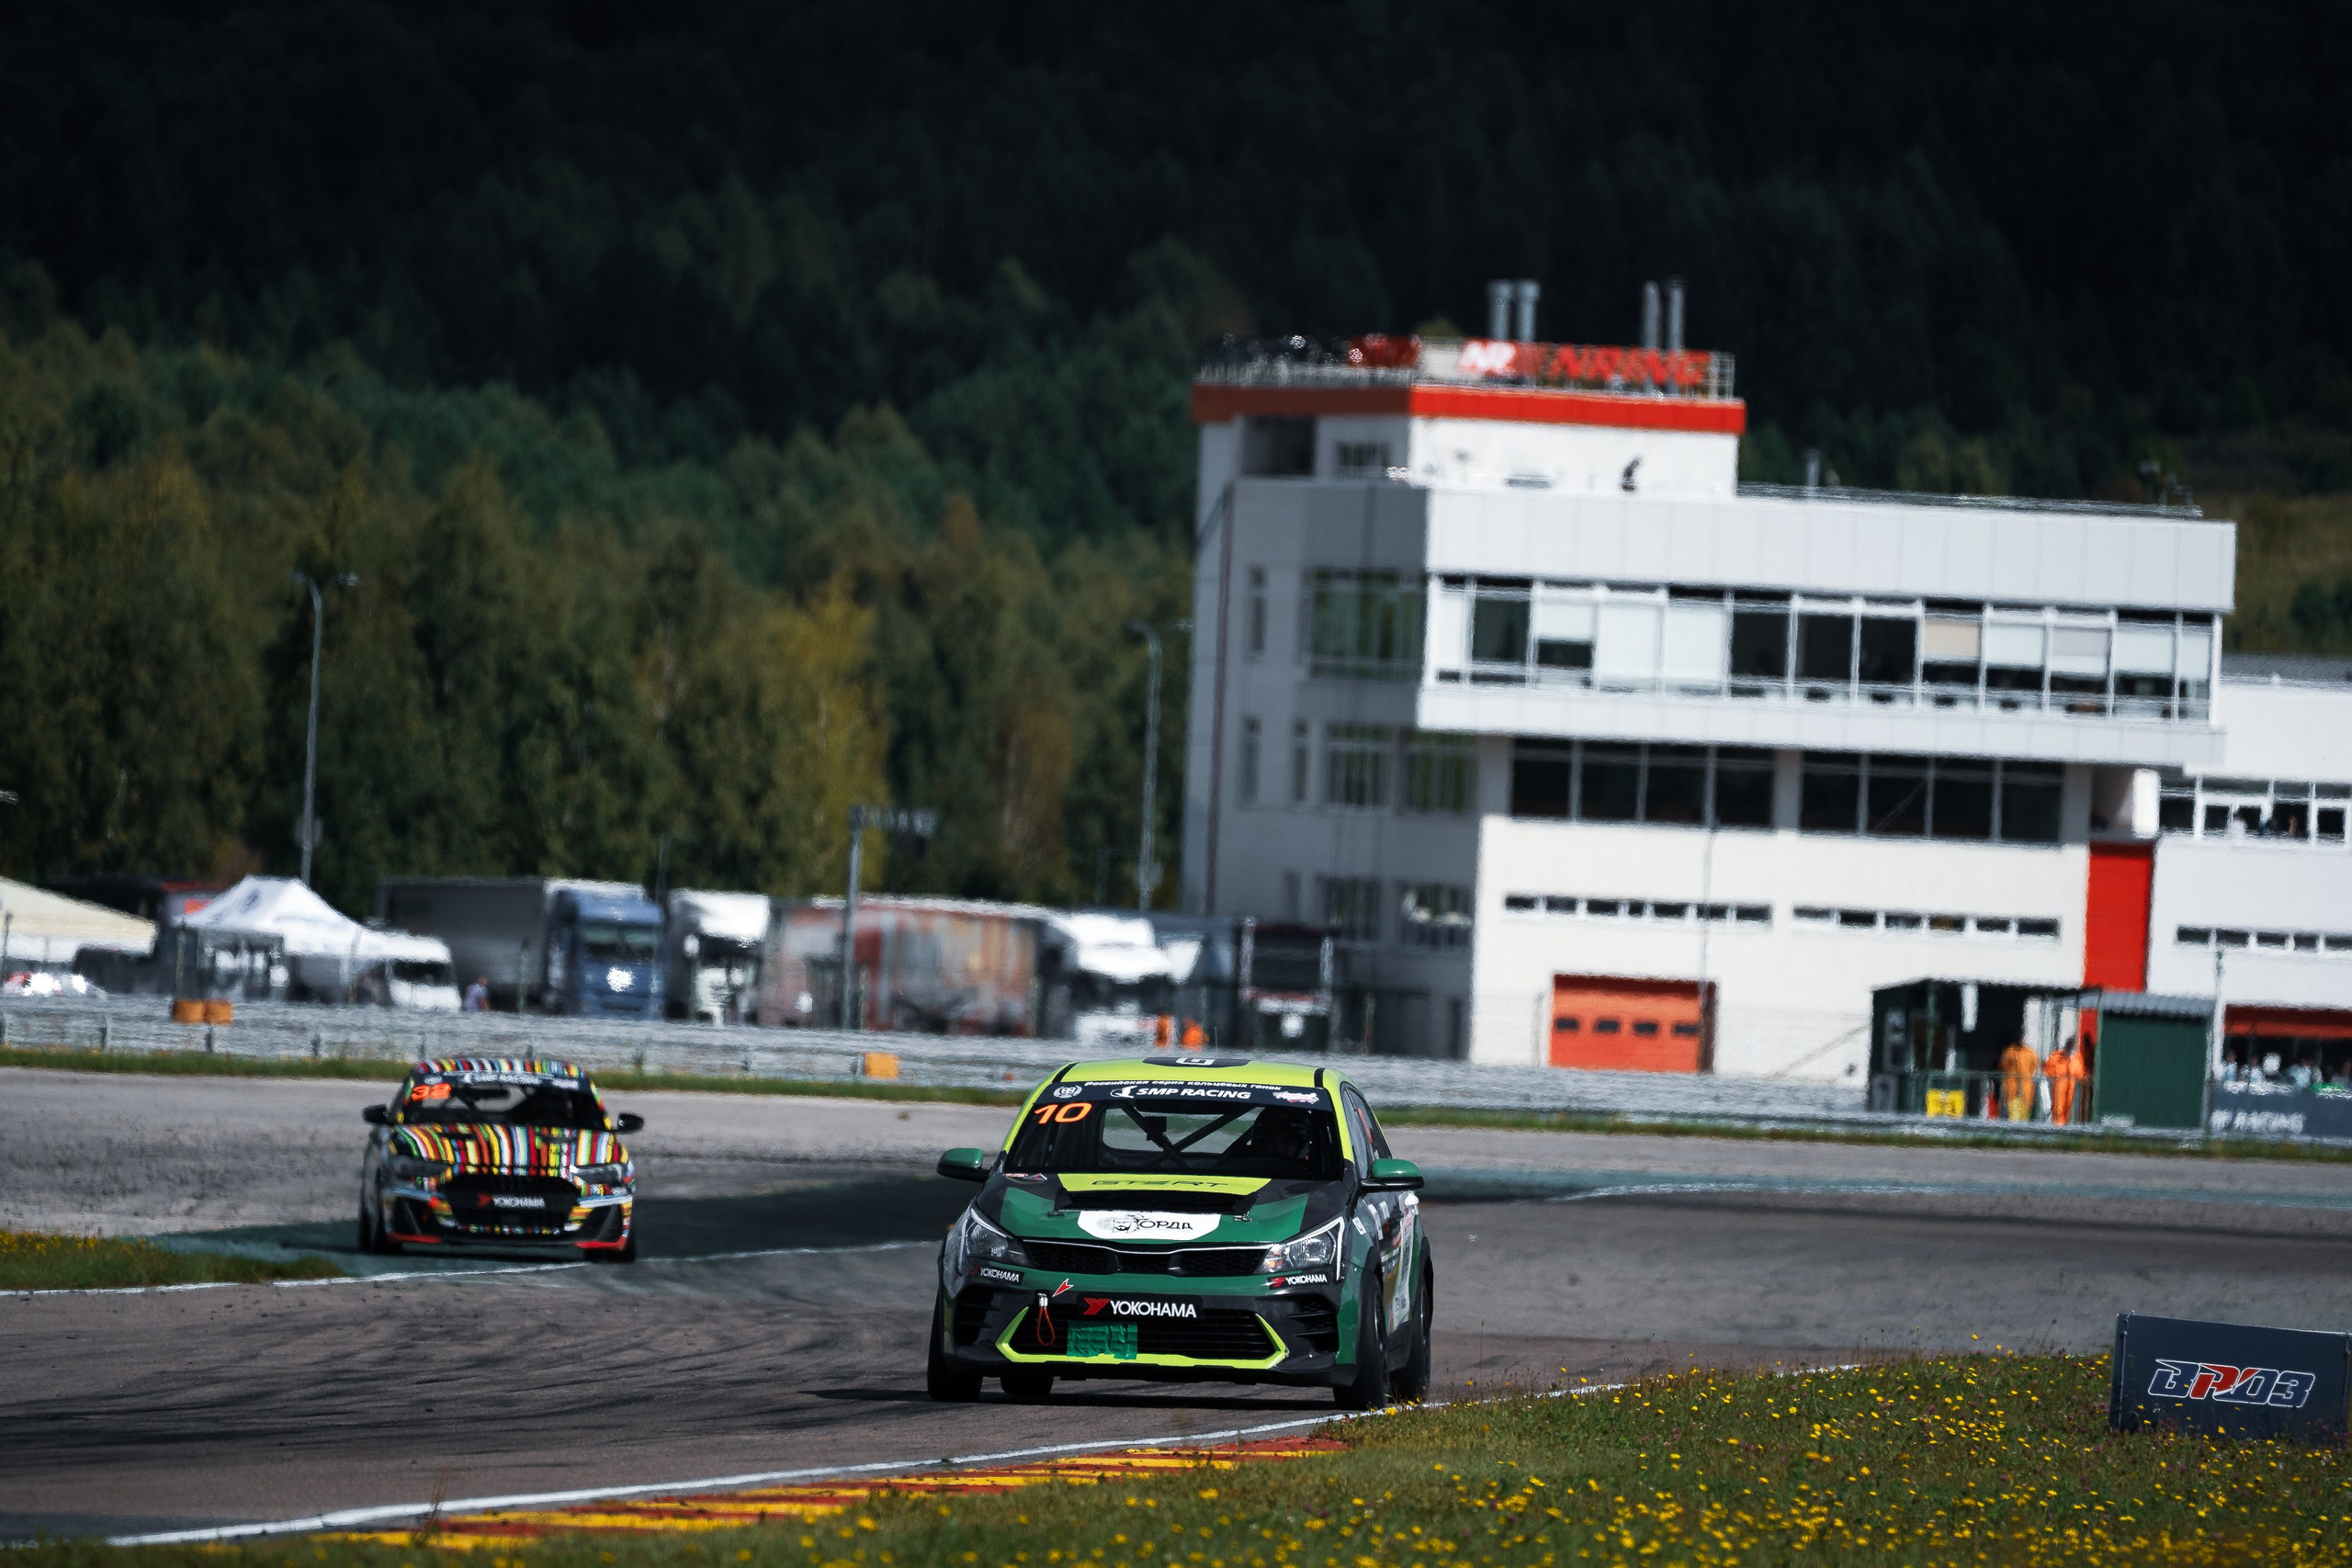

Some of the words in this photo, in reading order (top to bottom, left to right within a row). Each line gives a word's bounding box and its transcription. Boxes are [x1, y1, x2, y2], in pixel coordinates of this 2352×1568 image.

[1136, 1088, 1180, 1096] SMP
[1180, 1088, 1251, 1100] RACING
[1035, 1102, 1092, 1125] 10
[493, 1194, 546, 1208] YOKOHAMA
[1139, 1220, 1193, 1231] ОРДА
[980, 1268, 1020, 1283] YOKOHAMA
[1285, 1273, 1328, 1285] YOKOHAMA
[1110, 1300, 1197, 1318] YOKOHAMA
